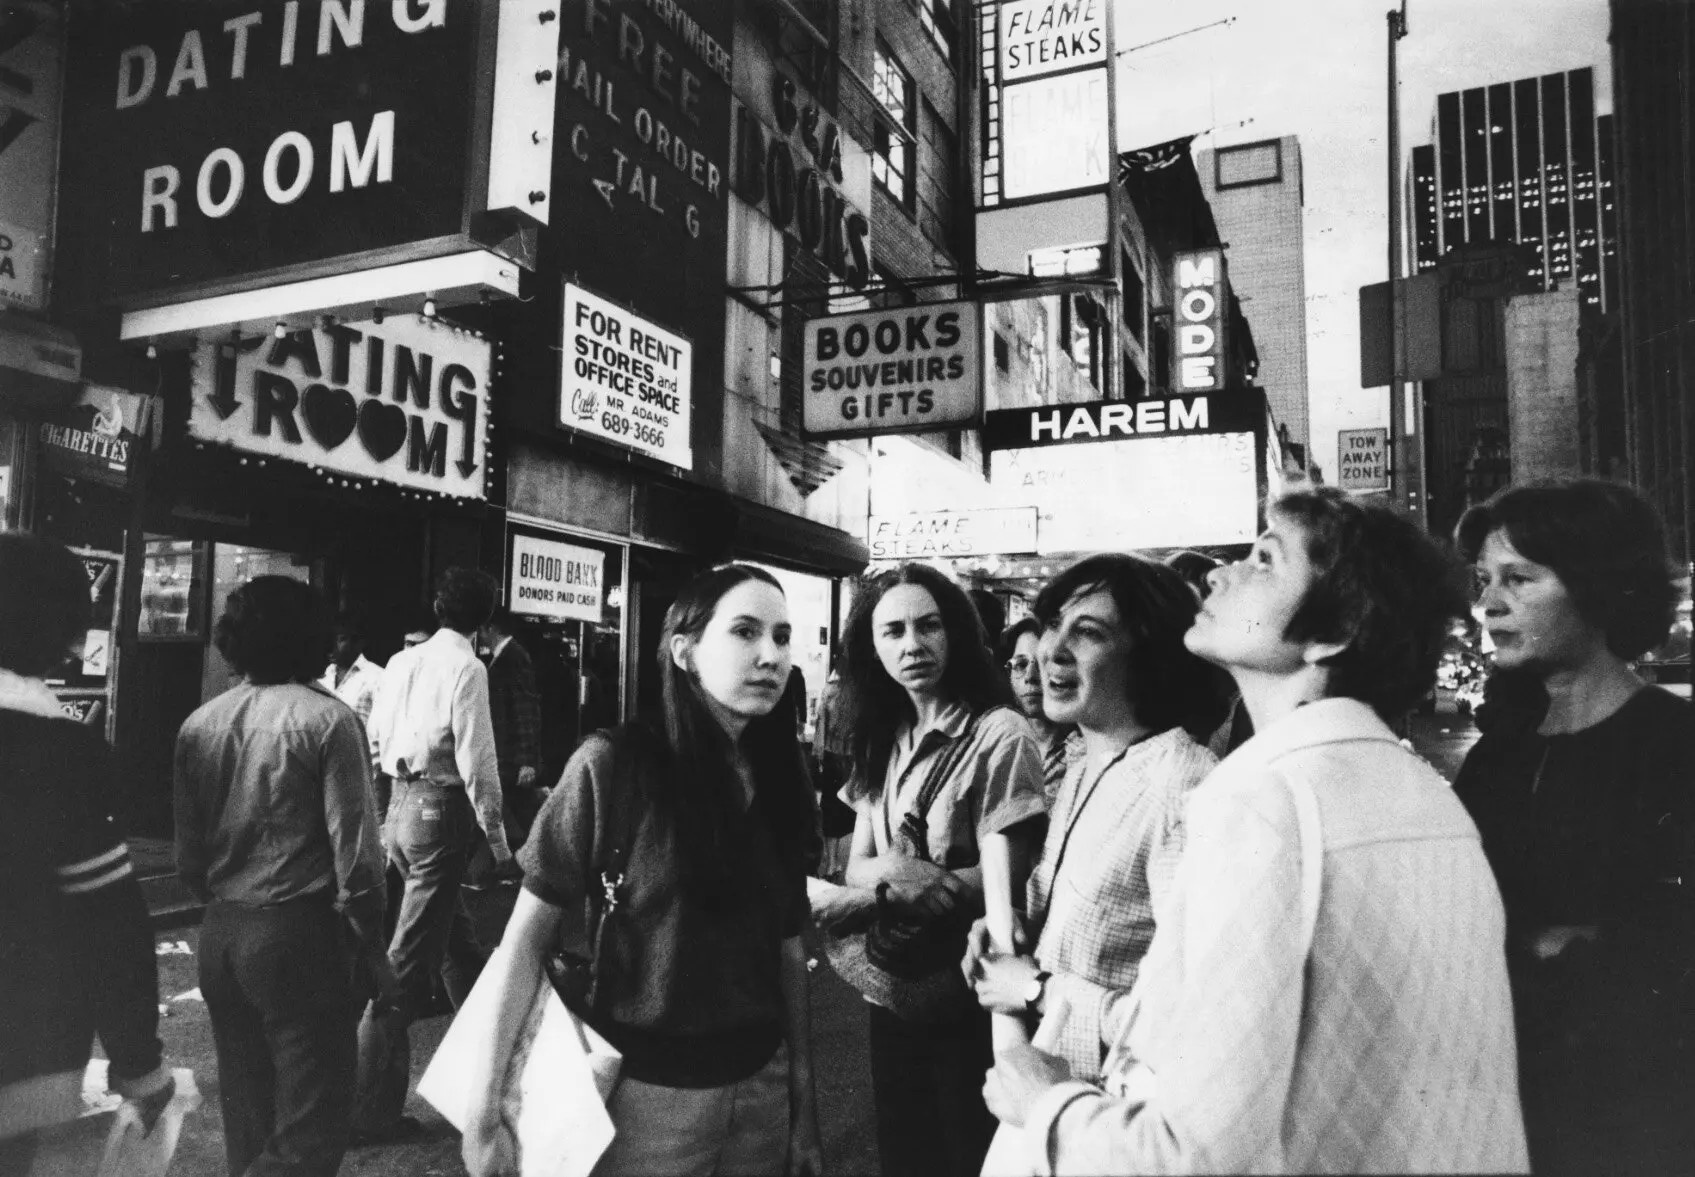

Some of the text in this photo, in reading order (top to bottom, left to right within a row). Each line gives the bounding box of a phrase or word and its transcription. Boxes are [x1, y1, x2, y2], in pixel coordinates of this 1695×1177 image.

[1007, 0, 1097, 38] FLAME
[1008, 27, 1102, 69] STEAKS
[141, 110, 396, 233] ROOM
[634, 106, 721, 200] ORDER
[575, 301, 683, 371] FOR RENT
[816, 312, 961, 361] BOOKS
[1179, 256, 1216, 388] MODE
[238, 325, 478, 421] ATING
[575, 334, 678, 394] STORES and
[811, 356, 965, 393] SOUVENIRS
[574, 357, 681, 415] OFFICE SPACE
[841, 389, 935, 422] GIFTS
[602, 411, 665, 448] 689-3666
[631, 405, 669, 428] ADAMS
[1030, 397, 1209, 441] HAREM
[40, 422, 129, 463] CIGARETTES
[1342, 451, 1382, 464] AWAY
[1348, 436, 1377, 449] TOW
[1342, 466, 1382, 479] ZONE
[876, 518, 970, 537] FLAME
[520, 552, 562, 582] BLOOD
[519, 586, 597, 606] DONORS PAID CASH
